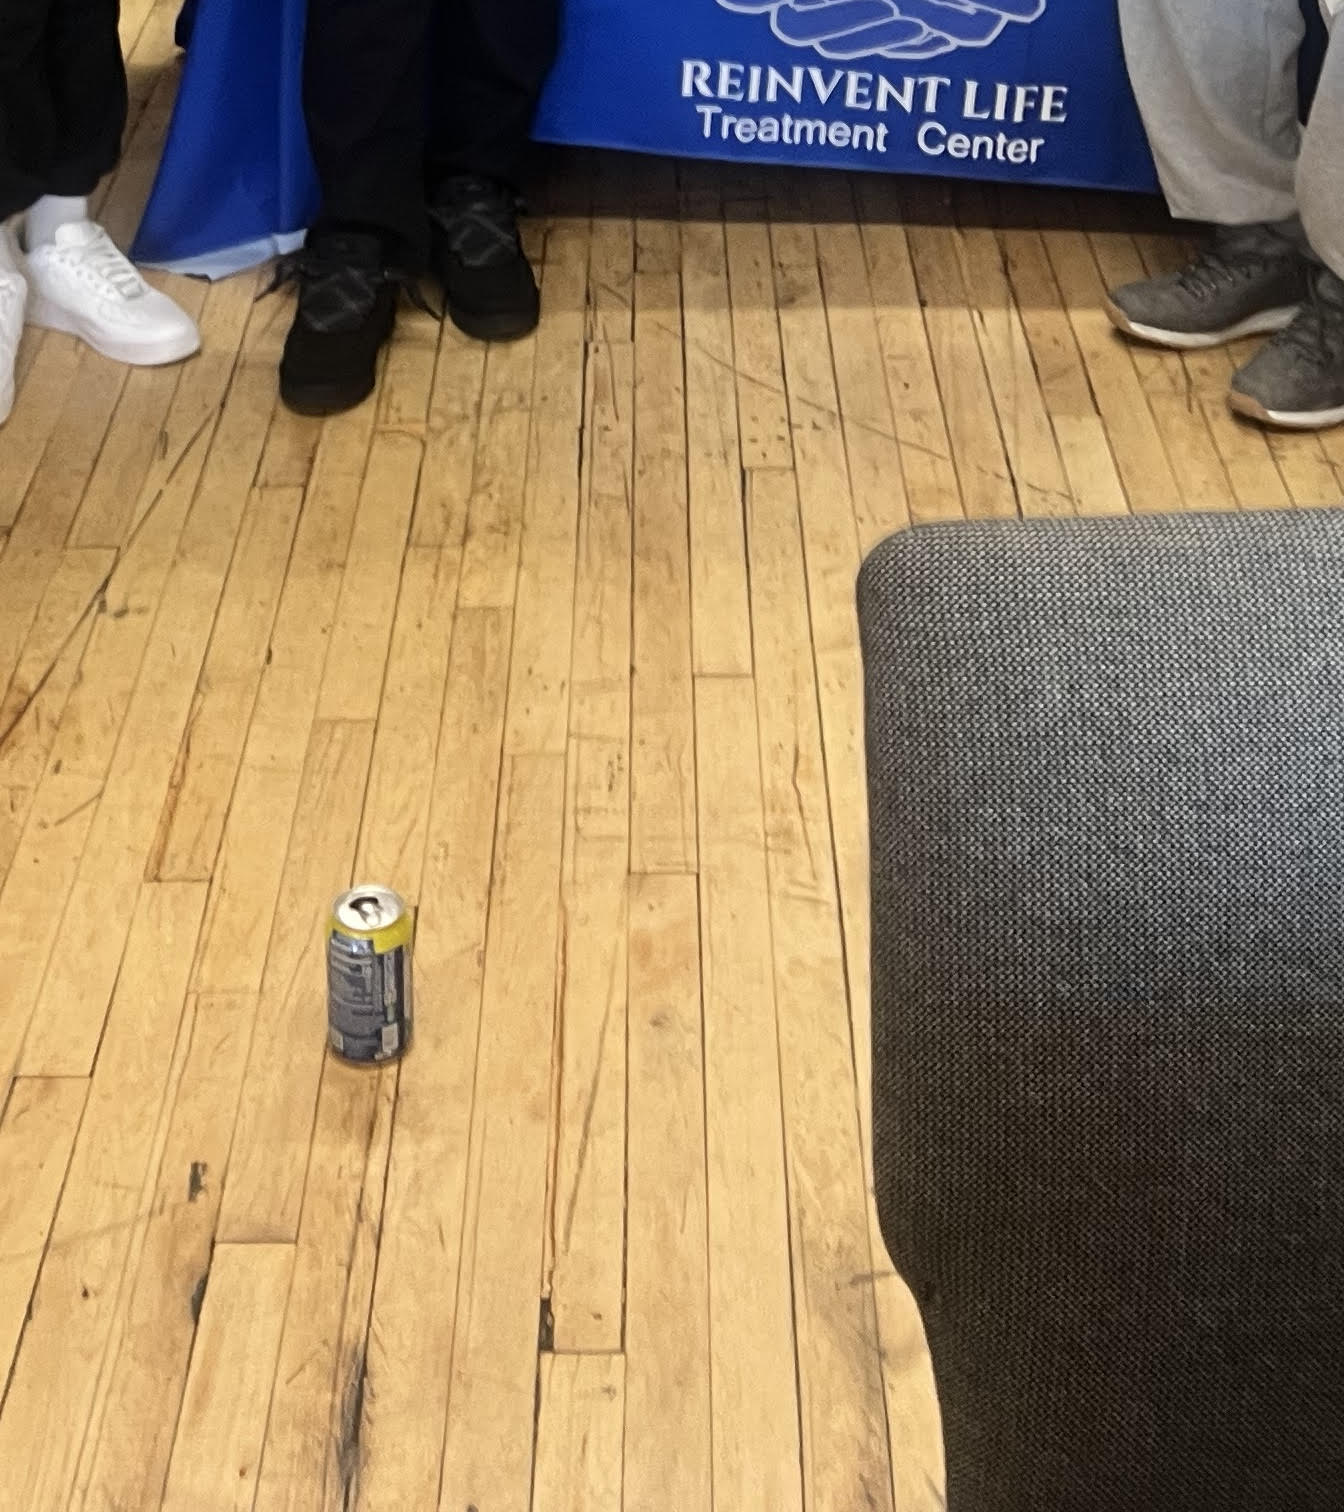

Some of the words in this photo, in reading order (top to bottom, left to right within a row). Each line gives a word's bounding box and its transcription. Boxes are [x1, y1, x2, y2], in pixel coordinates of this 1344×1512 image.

[680, 59, 952, 115] REINVENT
[962, 79, 1069, 123] LIFE
[695, 104, 890, 153] Treatment
[916, 121, 1045, 164] Center
